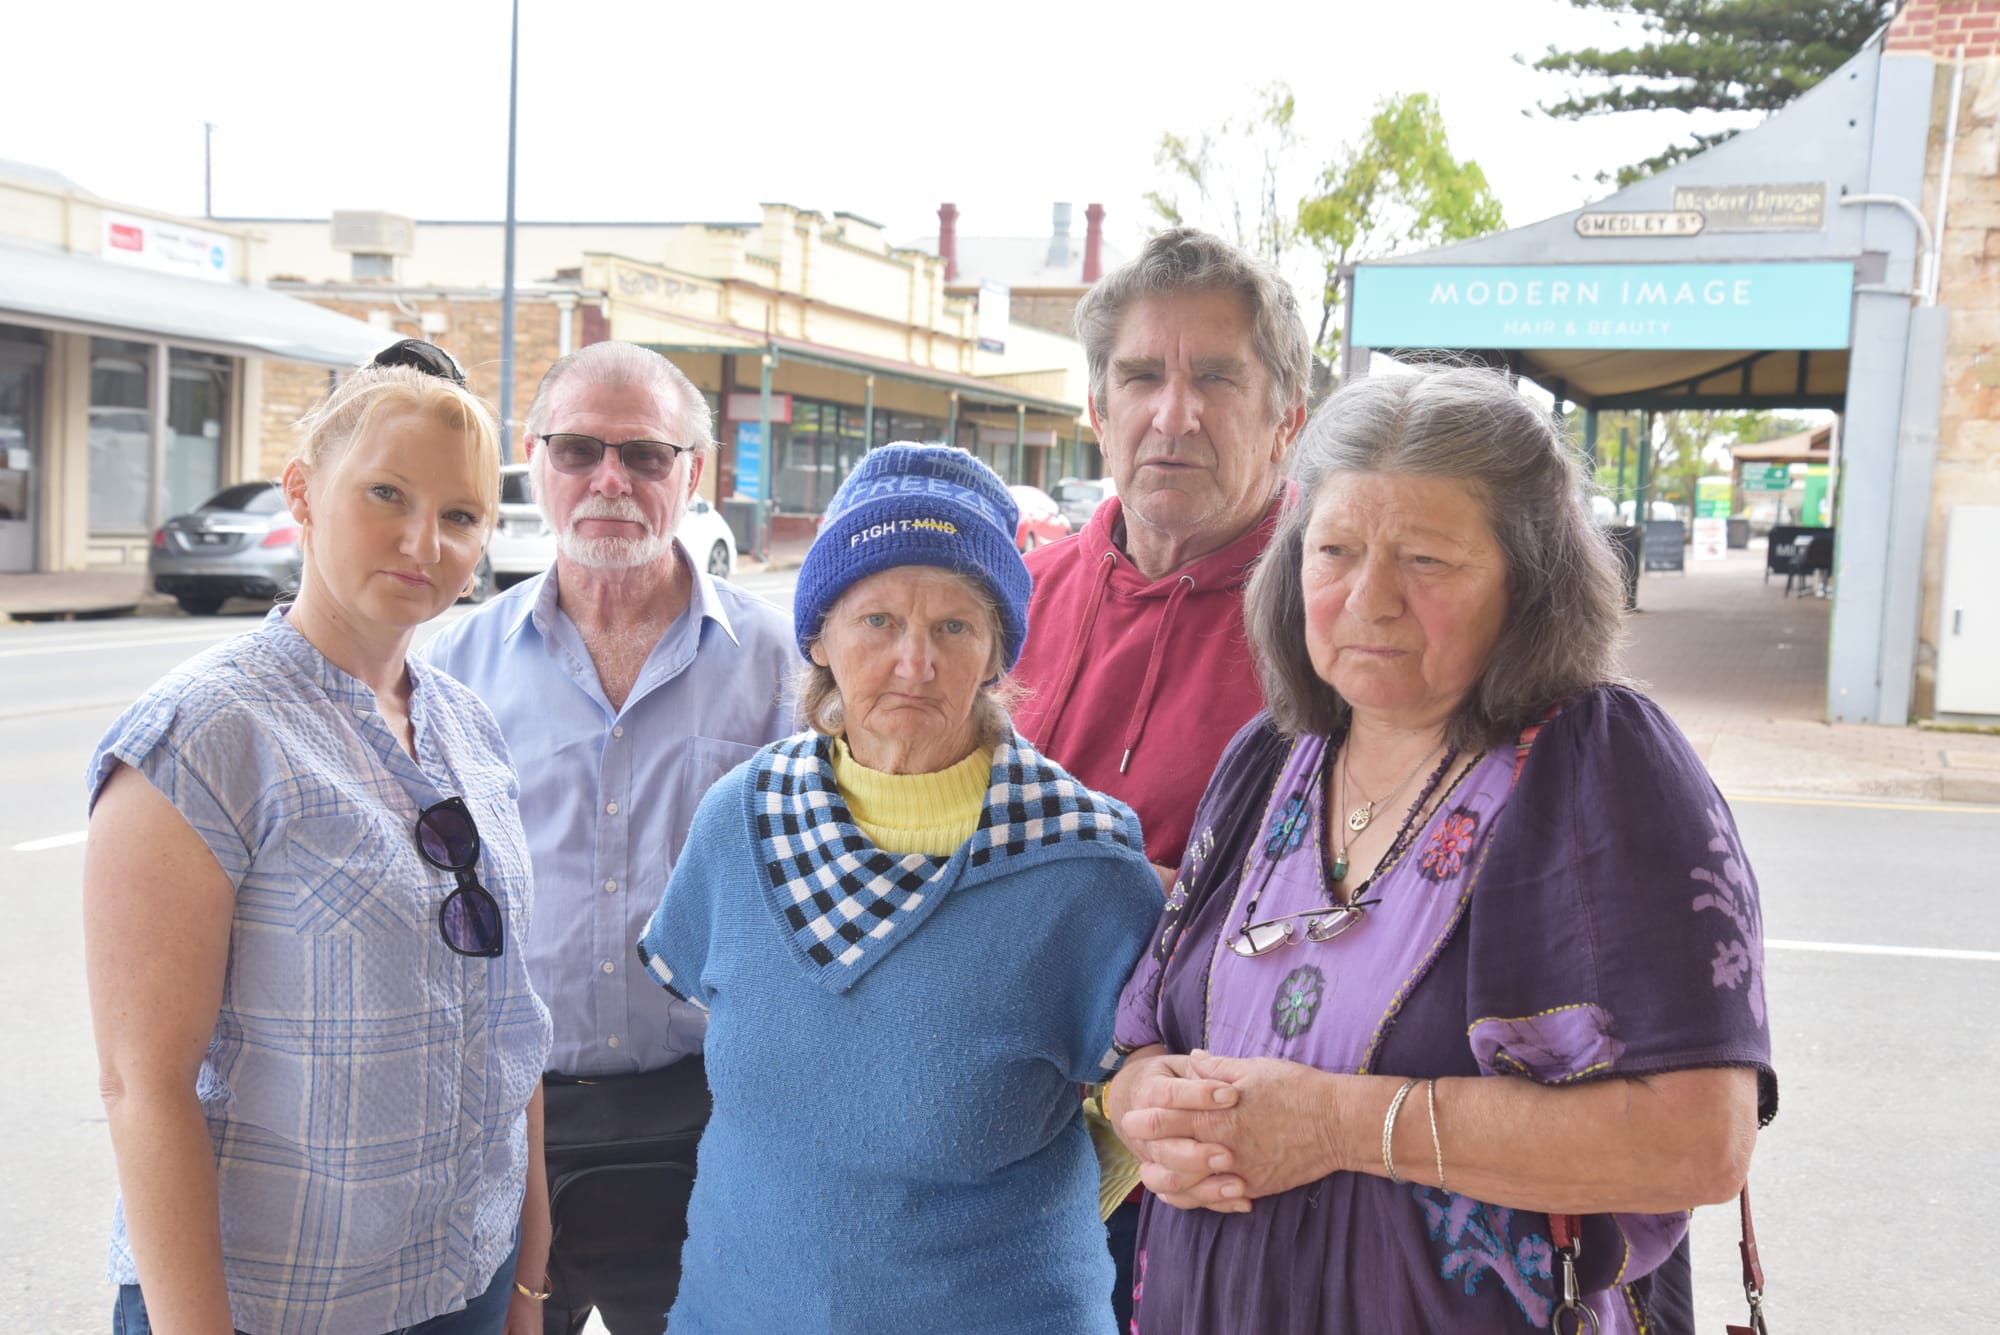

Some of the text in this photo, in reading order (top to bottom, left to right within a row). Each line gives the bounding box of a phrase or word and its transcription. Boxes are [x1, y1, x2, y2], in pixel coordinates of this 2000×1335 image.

[1580, 215, 1666, 232] SMEDLEY
[1429, 279, 1754, 306] MODERN IMAGE
[1503, 319, 1672, 336] HAIR & BEAUTY
[848, 474, 996, 519] FREEZE
